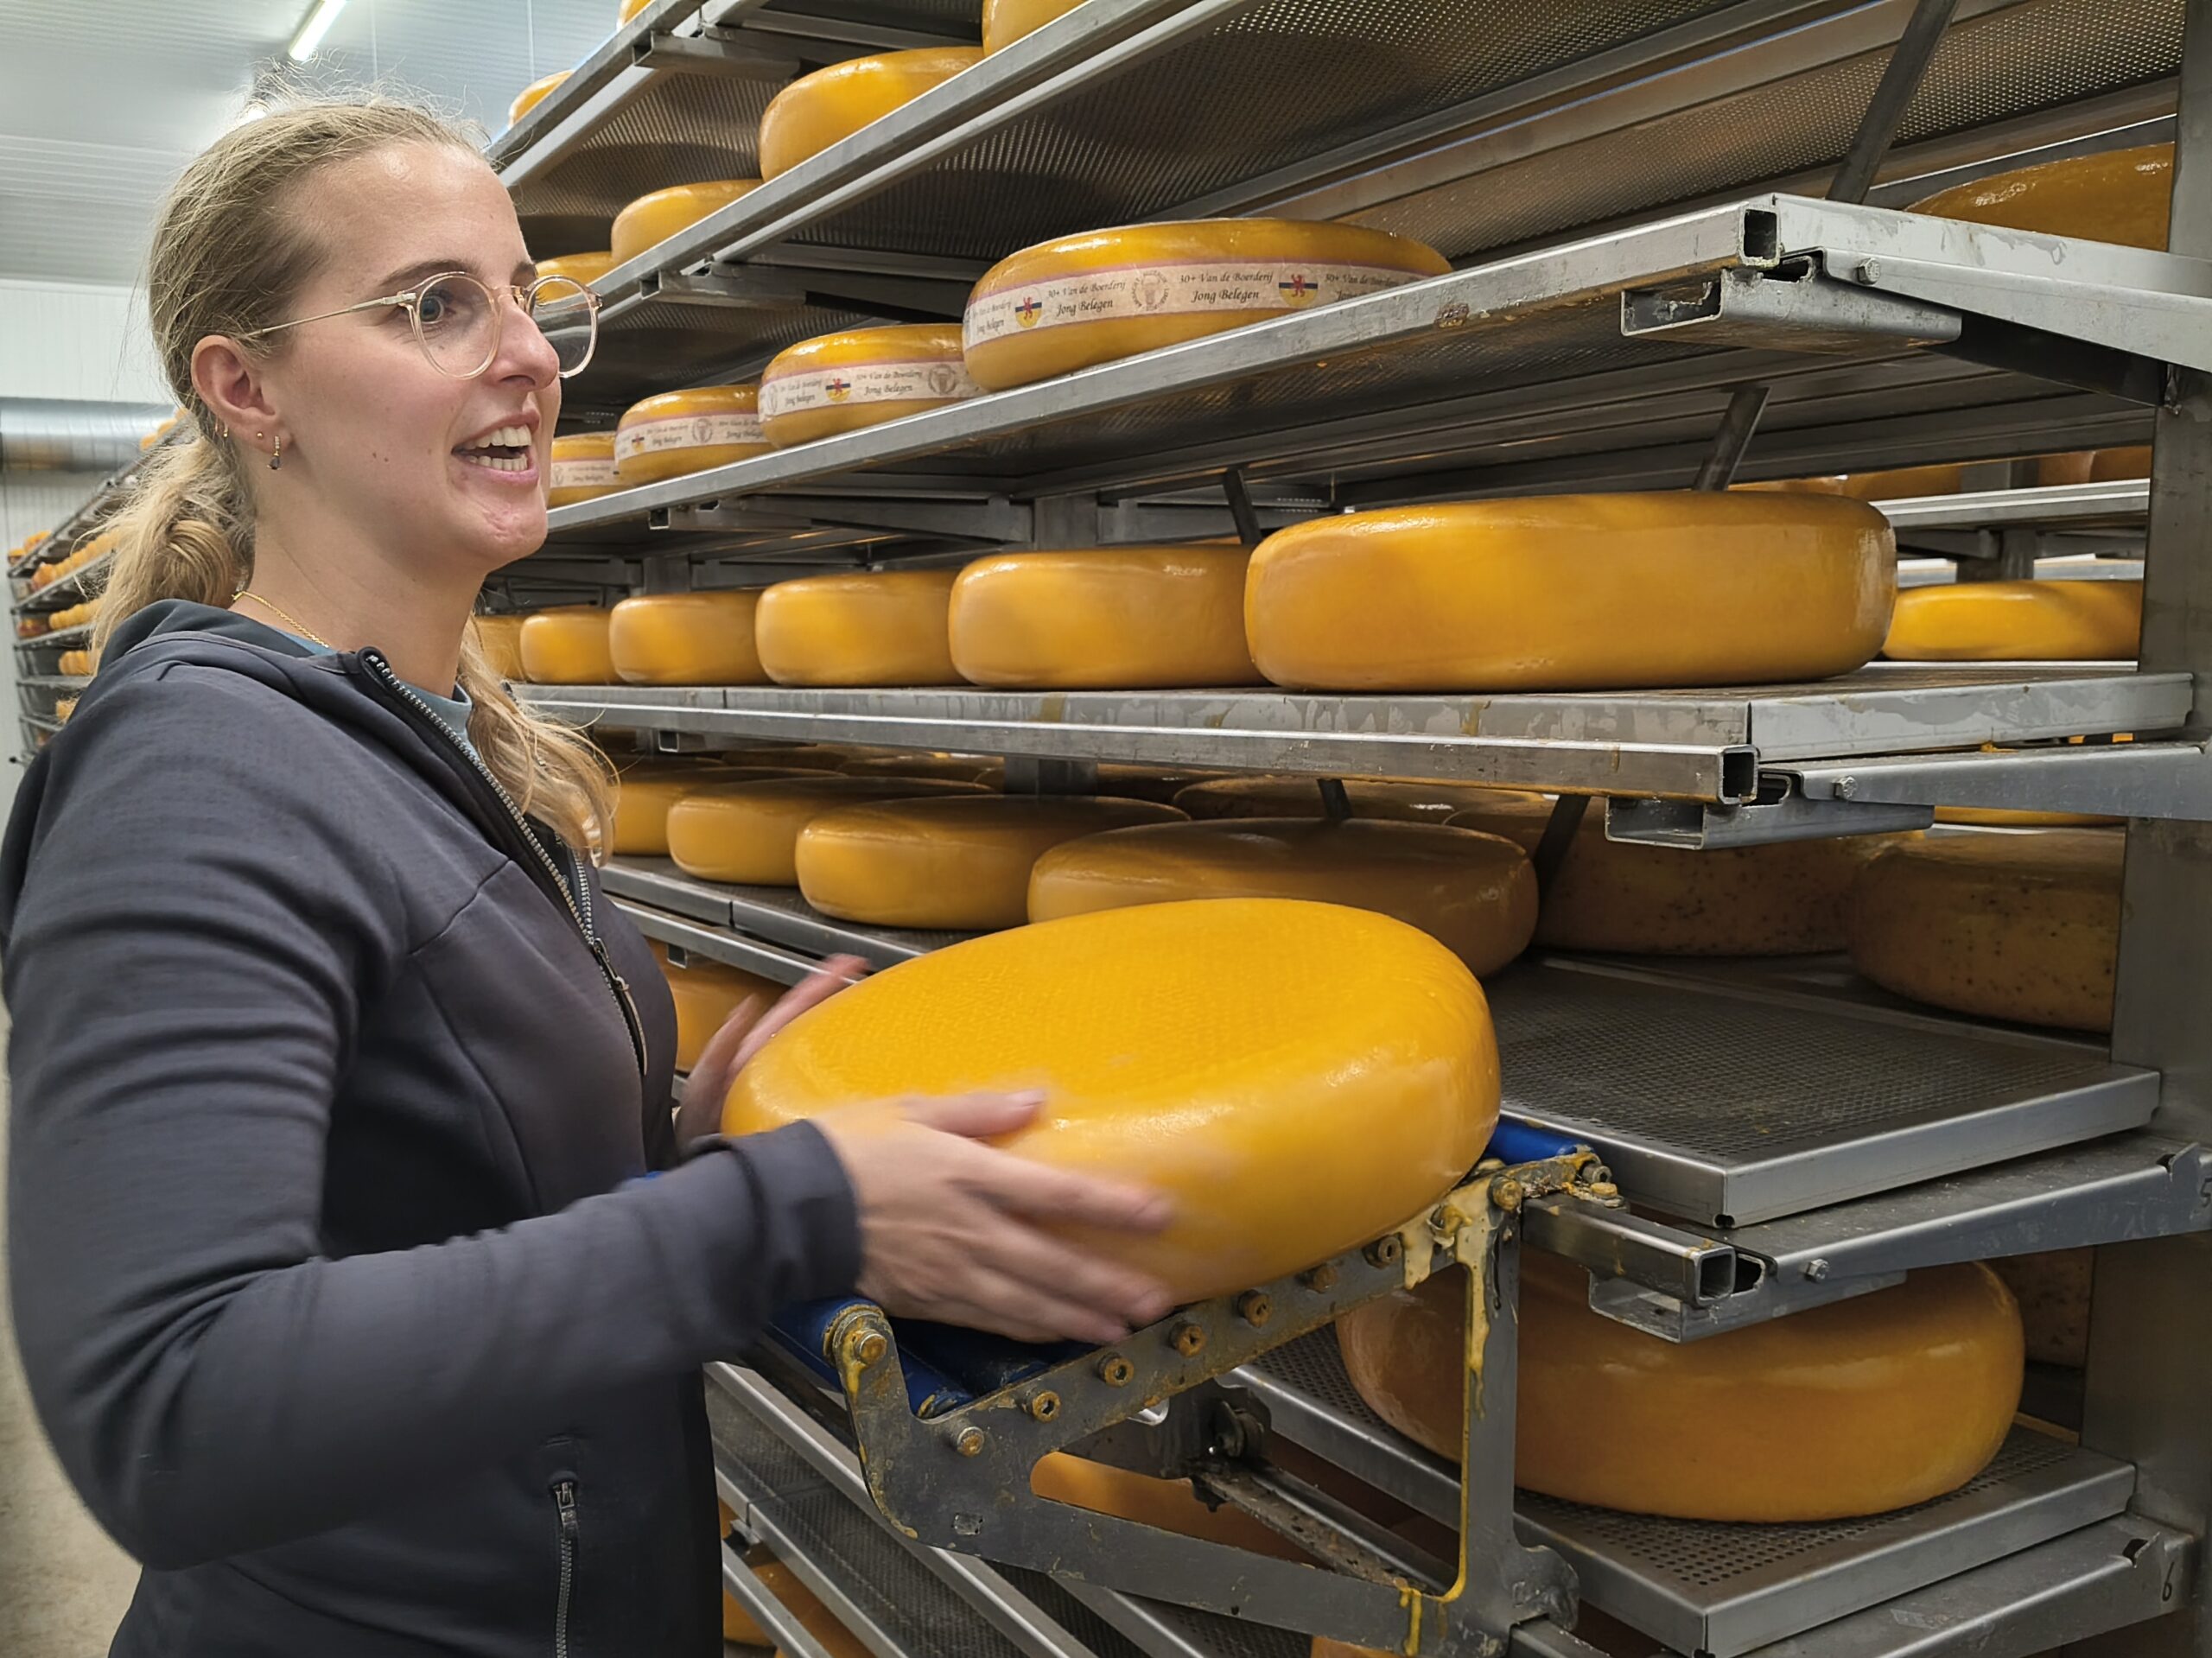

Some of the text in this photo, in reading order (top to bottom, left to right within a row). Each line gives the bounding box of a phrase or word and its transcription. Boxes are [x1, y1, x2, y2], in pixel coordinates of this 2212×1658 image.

[1198, 272, 1217, 283] Van
[1220, 270, 1230, 283] de
[1232, 270, 1274, 285] Boerderij
[1079, 283, 1089, 295] de
[1090, 279, 1127, 292] Boerderij
[1191, 287, 1260, 305] Jong Belegen
[1056, 298, 1114, 318] Jong Belegen
[2162, 1561, 2174, 1601] 6
